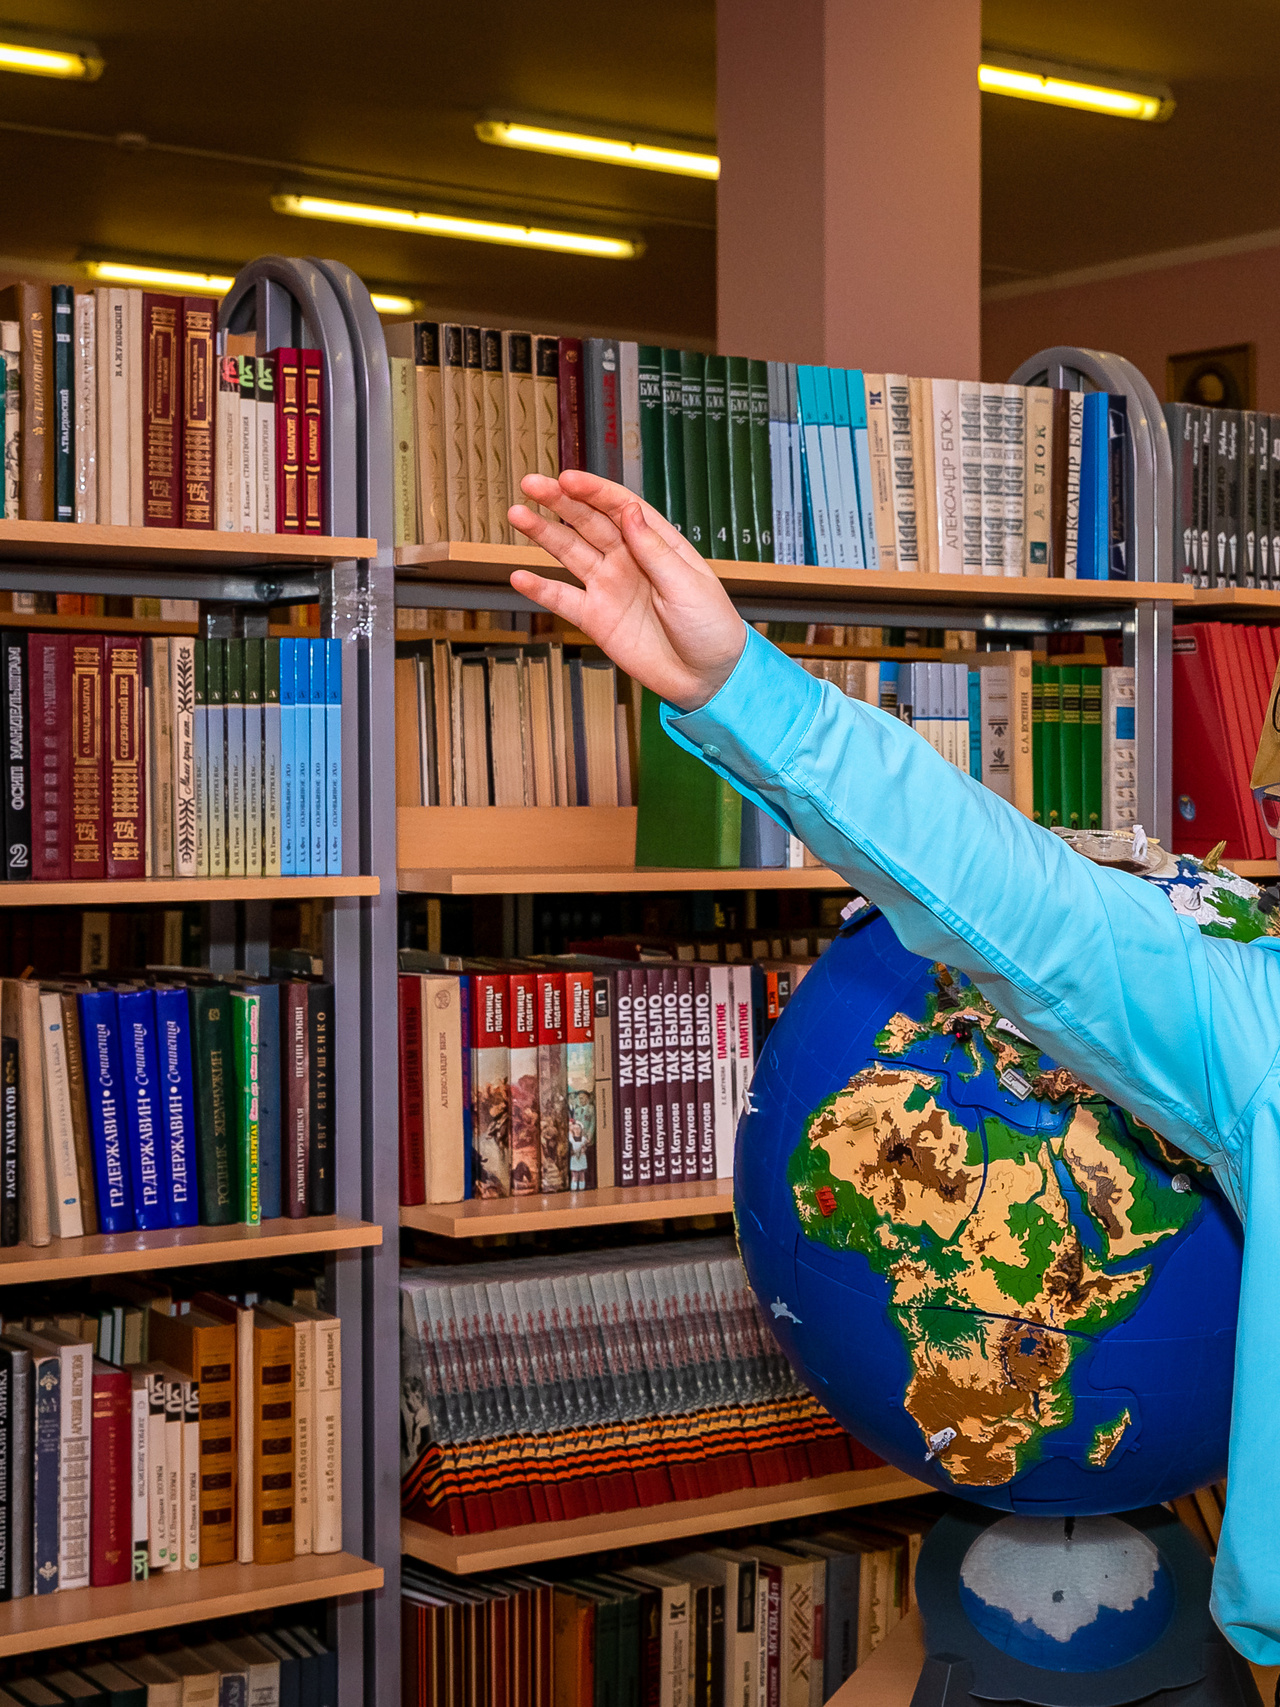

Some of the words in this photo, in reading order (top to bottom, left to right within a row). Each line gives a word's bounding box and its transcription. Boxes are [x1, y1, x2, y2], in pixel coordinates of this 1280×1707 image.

[640, 382, 661, 397] БЛОК
[682, 393, 702, 408] БЛОК
[705, 395, 725, 409] БЛОК
[940, 409, 954, 452] БЛОК
[1068, 400, 1083, 448] БЛОК
[242, 416, 252, 479] СТИХОТВОРЕНИЯ
[261, 419, 270, 482] СТИХОТВОРЕНИЯ
[1033, 425, 1046, 495] БЛОК
[942, 456, 958, 549] АЛЕКСАНДР
[1065, 456, 1081, 570] АЛЕКСАНДР
[692, 525, 702, 542] 3
[716, 527, 728, 543] 4
[741, 529, 751, 546] 5
[761, 530, 772, 546] 6
[8, 646, 24, 761] МАНДЕЛЬШТАМ
[119, 676, 129, 696] ВЕК
[82, 677, 92, 744] МАНДЕЛЬШТАМ
[118, 696, 129, 759] СЕРЕБРЯНЫЙ
[1020, 691, 1030, 733] ЕСЕНИН
[11, 765, 26, 811] ОСИП
[10, 843, 28, 868] 2
[295, 1006, 305, 1044] ЛЮБВИ
[485, 985, 495, 1033] СТРАНИЦЫ
[494, 993, 503, 1032] ПОДВИГА
[516, 985, 526, 1033] СТРАНИЦЫ
[524, 993, 535, 1032] ПОДВИГА
[543, 983, 554, 1029] СТРАНИЦЫ
[552, 989, 562, 1029] ПОДВИГА
[573, 982, 583, 1028] СТРАНИЦЫ
[581, 989, 591, 1028] ПОДВИГА
[618, 983, 633, 1051] БЫЛО...
[634, 984, 649, 1051] БЫЛО...
[649, 982, 664, 1048] БЫЛО...
[664, 980, 680, 1047] БЫЛО...
[679, 981, 694, 1047] БЫЛО...
[696, 981, 711, 1047] БЫЛО...
[439, 1032, 447, 1050] БЕК
[715, 1003, 727, 1060] ПАМЯТНОЕ
[738, 1002, 750, 1059] ПАМЯТНОЕ
[295, 1044, 305, 1078] ПЕСНИ
[317, 1011, 327, 1110] ЕВТУШЕНКО
[439, 1052, 449, 1109] АЛЕКСАНДР
[619, 1053, 634, 1088] ТАК
[635, 1053, 650, 1088] ТАК
[650, 1051, 665, 1085] ТАК
[665, 1049, 681, 1084] ТАК
[680, 1050, 695, 1084] ТАК
[697, 1049, 712, 1083] ТАК
[210, 1049, 226, 1137] ЖЕМЧУЖИН
[6, 1086, 17, 1155] ГАМЗАТОВ
[622, 1107, 635, 1159] Катукова
[639, 1107, 652, 1159] Катукова
[653, 1104, 666, 1156] Катукова
[670, 1103, 683, 1154] Катукова
[685, 1103, 698, 1154] Катукова
[701, 1102, 714, 1153] Катукова
[102, 1099, 125, 1208] Г.Р.ДЕРЖАВИН
[137, 1097, 158, 1206] Г.Р.ДЕРЖАВИН
[169, 1095, 188, 1203] Г.Р.ДЕРЖАВИН
[250, 1124, 258, 1165] ЗВЕРЯТАХ
[654, 1157, 666, 1178] Е.С.
[670, 1155, 683, 1176] Е.С.
[685, 1155, 698, 1176] Е.С.
[702, 1155, 714, 1175] Е.С.
[6, 1159, 16, 1199] РАСУЛ
[296, 1158, 306, 1204] ЛЮДМИЛА
[623, 1160, 635, 1181] Е.С.
[640, 1160, 652, 1181] Е.С.
[250, 1176, 258, 1212] РЕБЯТАХ
